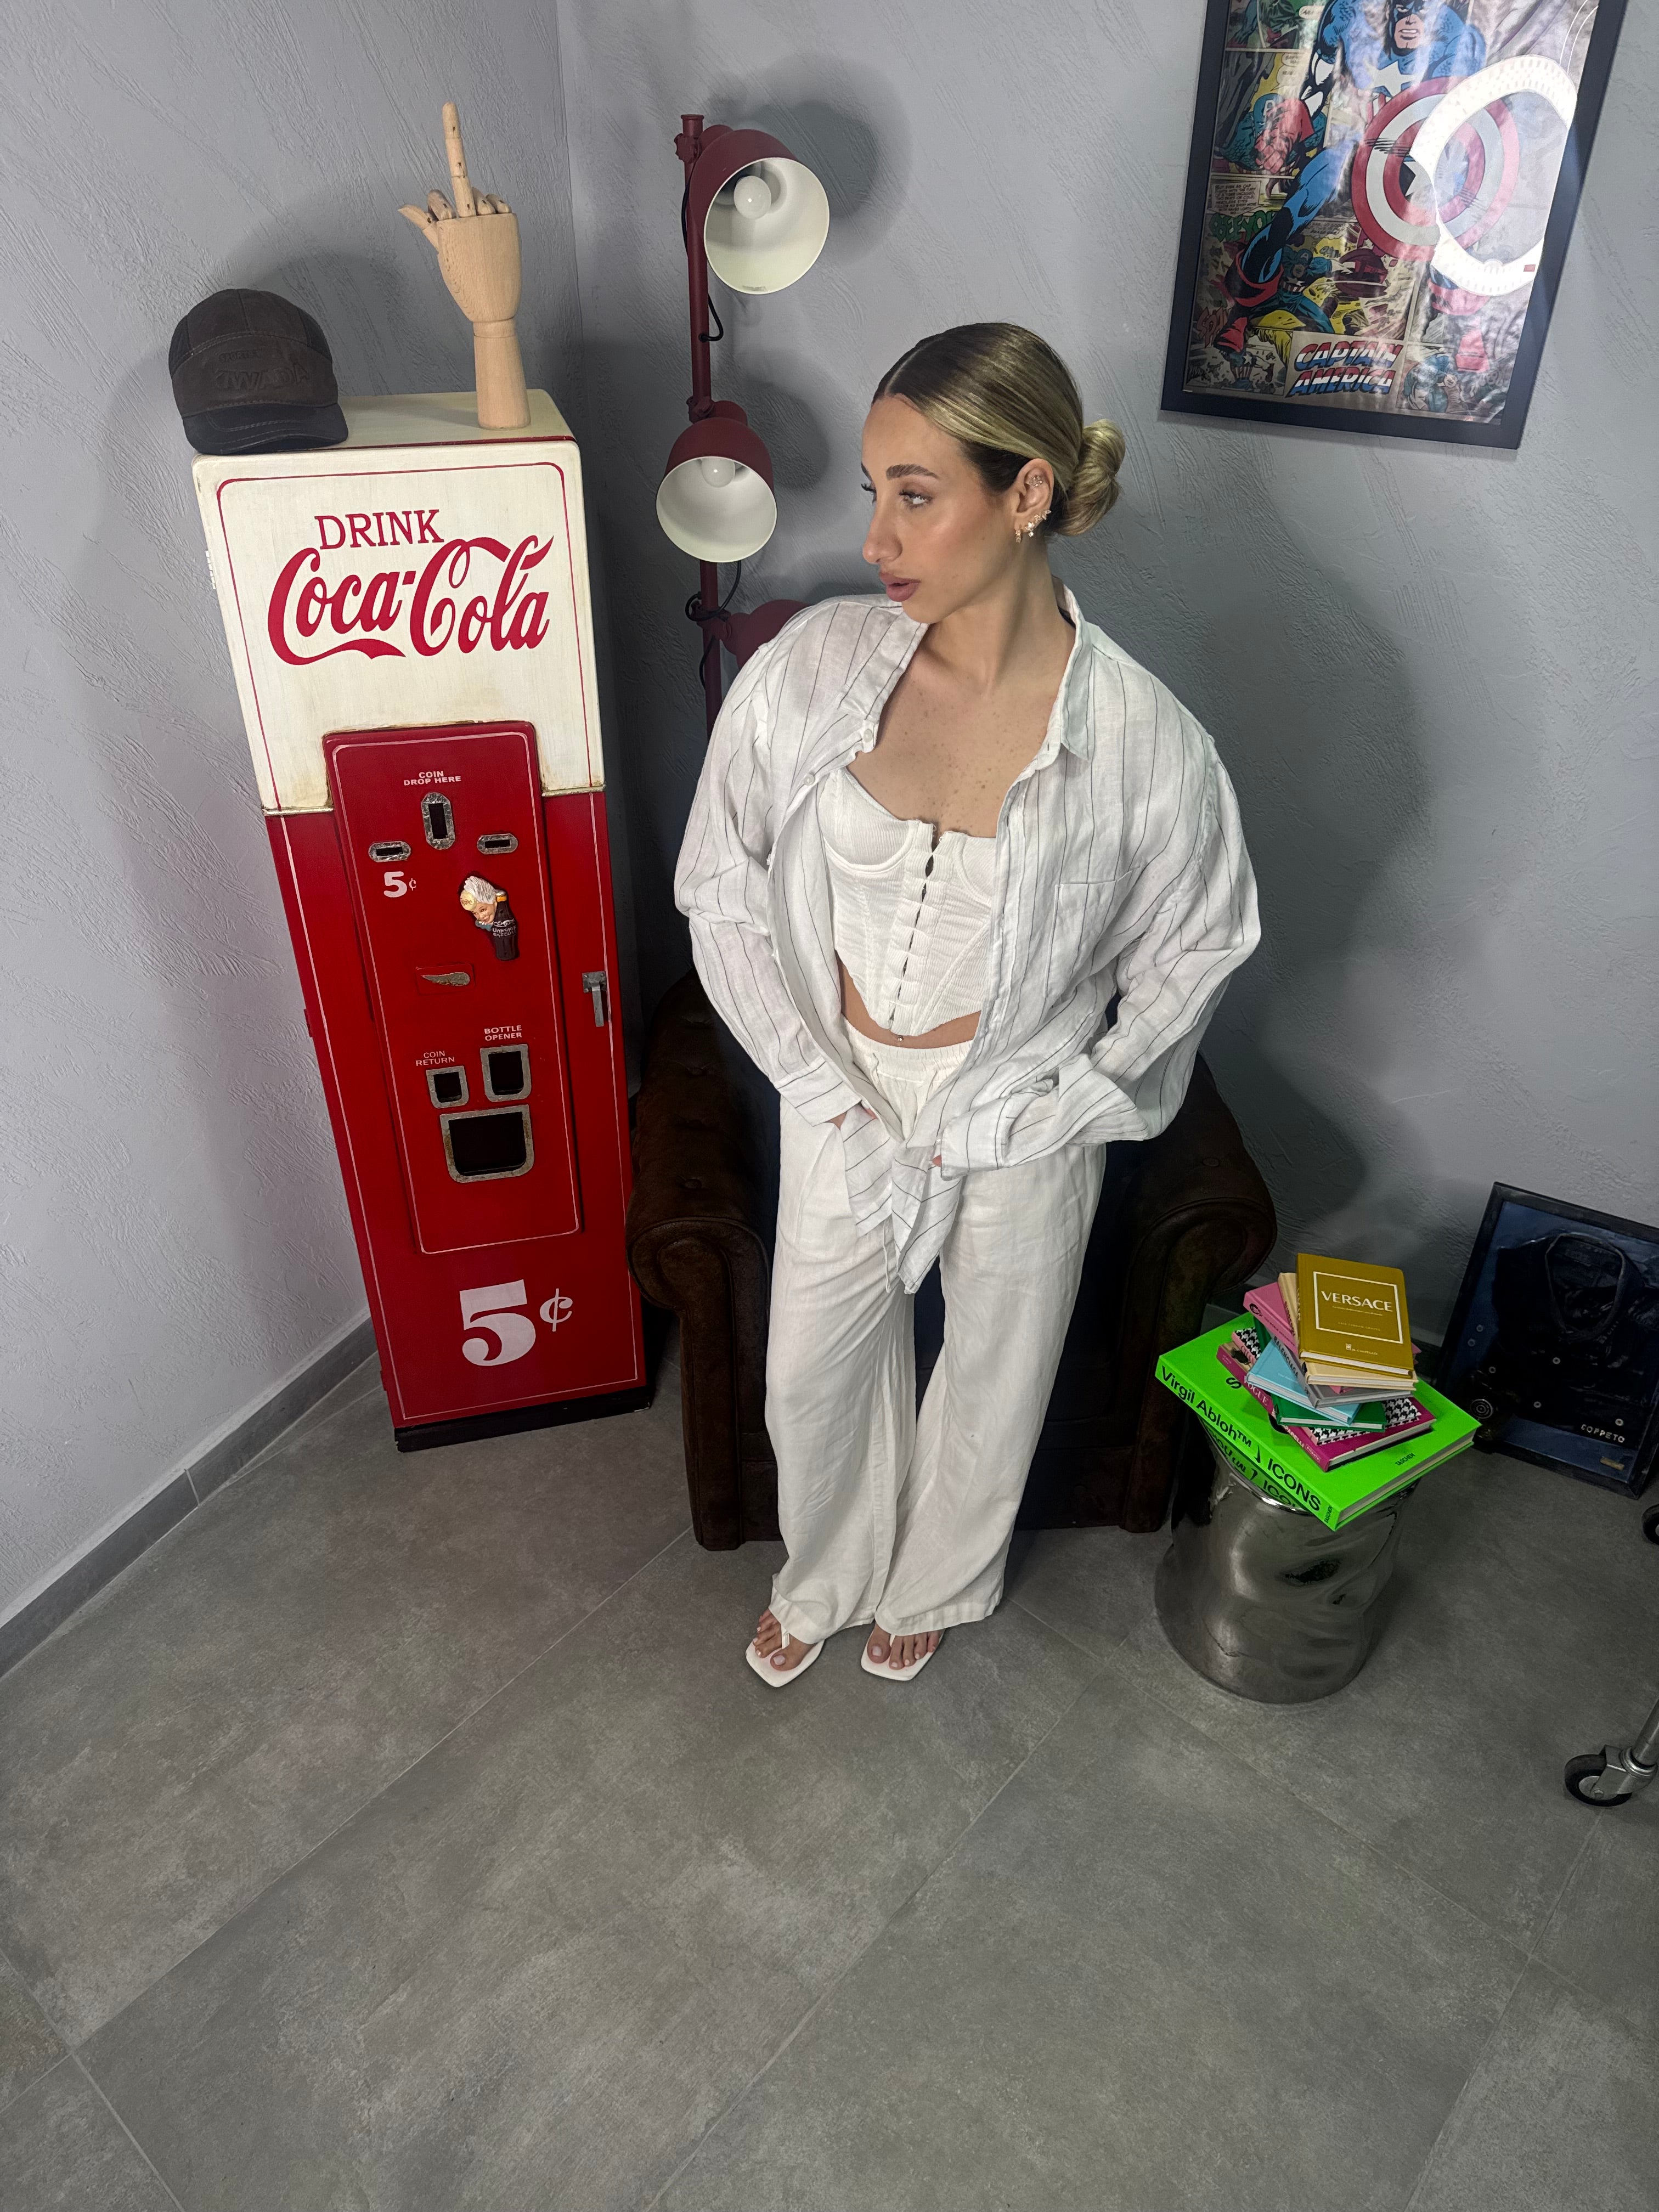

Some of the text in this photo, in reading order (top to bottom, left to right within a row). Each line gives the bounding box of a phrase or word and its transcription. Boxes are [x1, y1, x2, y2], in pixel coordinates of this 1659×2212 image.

[1294, 340, 1403, 371] CAPTAIN
[1285, 366, 1396, 398] AMERICA
[314, 509, 444, 550] DRINK
[268, 535, 554, 665] Coca-Cola
[419, 770, 444, 778] COIN
[484, 1025, 522, 1034] BOTTLE
[484, 1032, 522, 1041] OPENER
[415, 1056, 455, 1066] RETURN
[423, 1050, 445, 1059] COIN
[1321, 1290, 1393, 1312] VERSACE
[1273, 1335, 1299, 1379] BALENCIAGA
[1161, 1365, 1195, 1404] Virgil
[1267, 1458, 1321, 1511] ICONS
[1395, 1452, 1416, 1466] TASCHEN
[1324, 1505, 1333, 1523] TASCHEN
